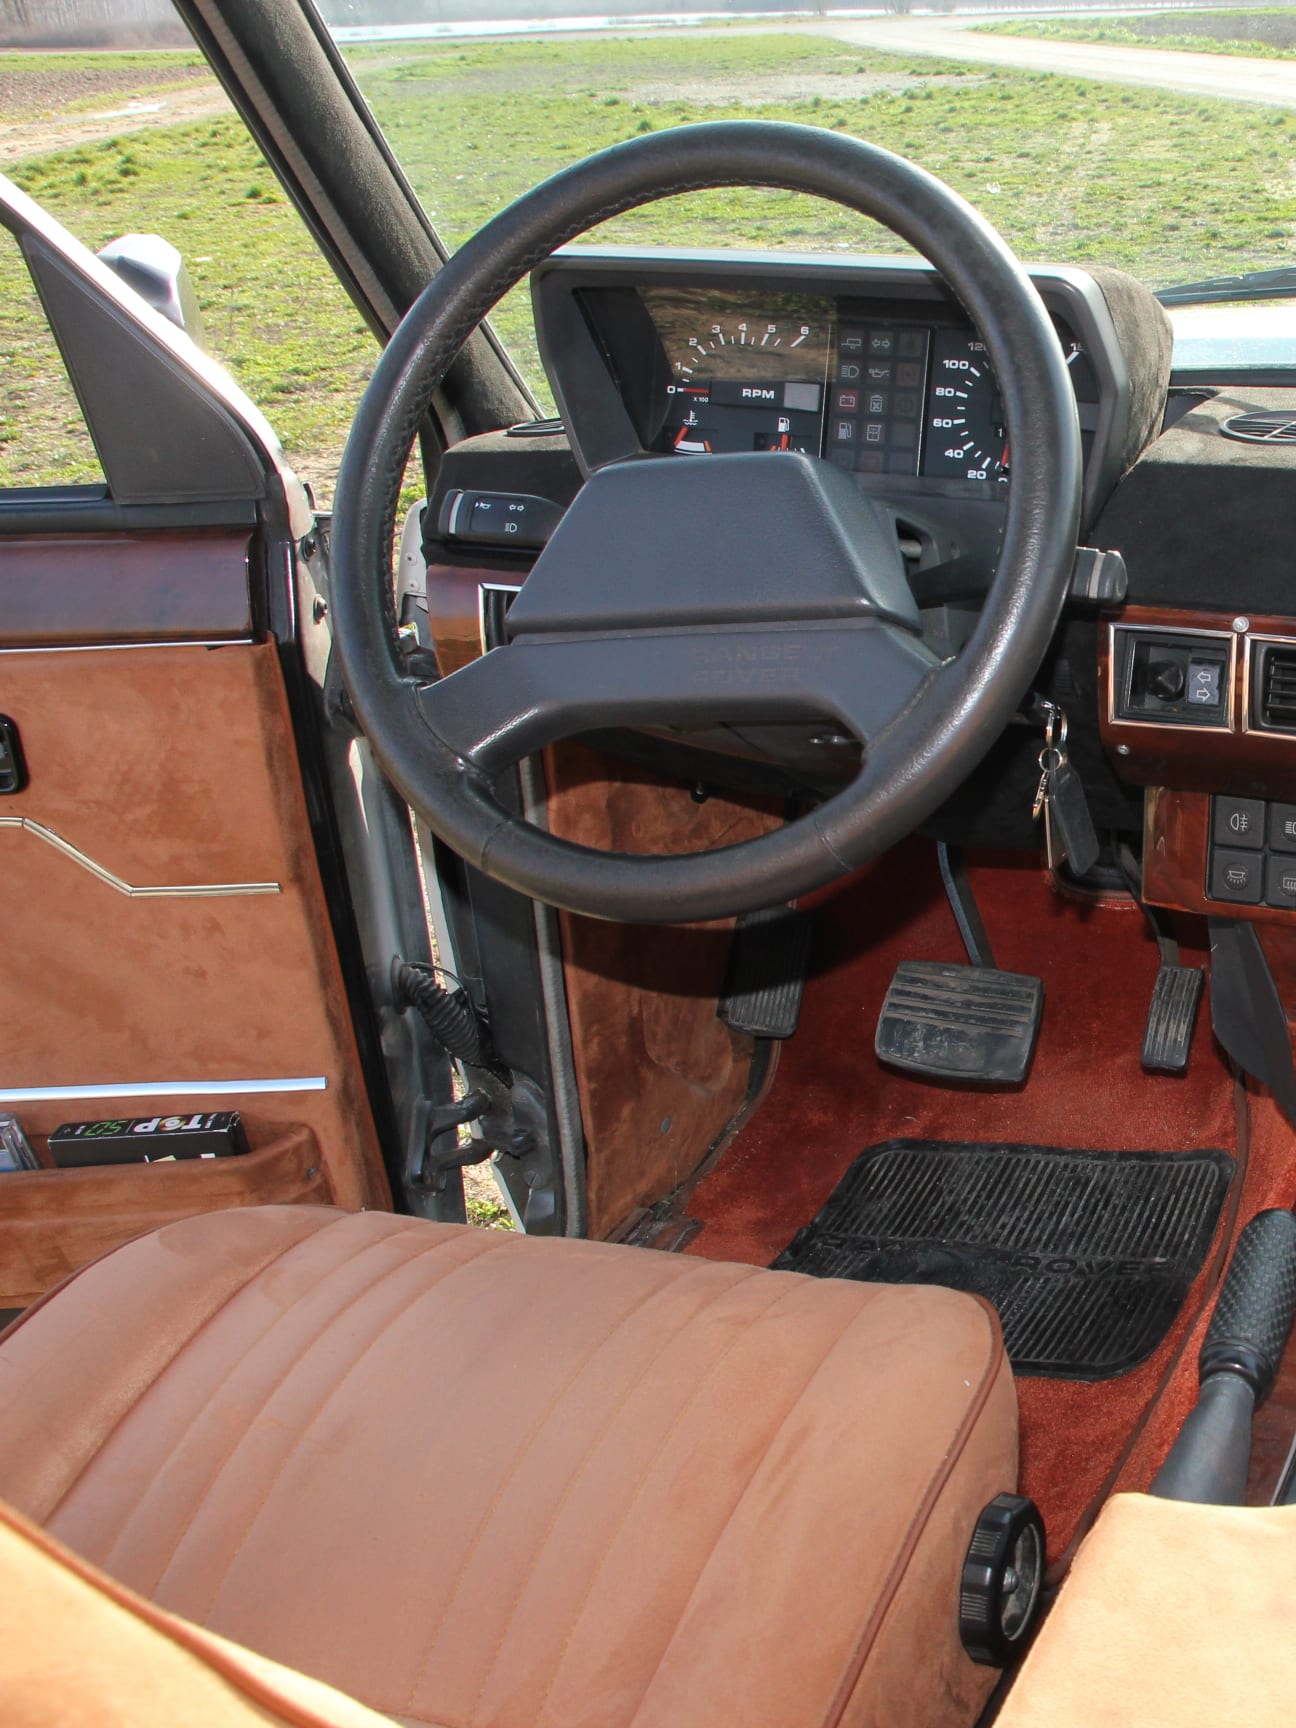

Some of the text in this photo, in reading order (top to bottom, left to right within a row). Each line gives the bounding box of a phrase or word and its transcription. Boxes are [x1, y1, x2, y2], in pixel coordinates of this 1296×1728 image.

[711, 325, 720, 333] 3
[738, 323, 747, 331] 4
[767, 325, 776, 333] 5
[800, 326, 809, 335] 6
[688, 338, 698, 346] 2
[968, 342, 987, 351] 12
[675, 362, 681, 370] 1
[942, 359, 969, 370] 100
[667, 385, 676, 394] 0
[742, 387, 775, 399] RPM
[935, 387, 954, 397] 80
[933, 418, 952, 428] 60
[944, 449, 964, 459] 40
[967, 470, 987, 480] 20
[134, 1114, 204, 1134] TOP
